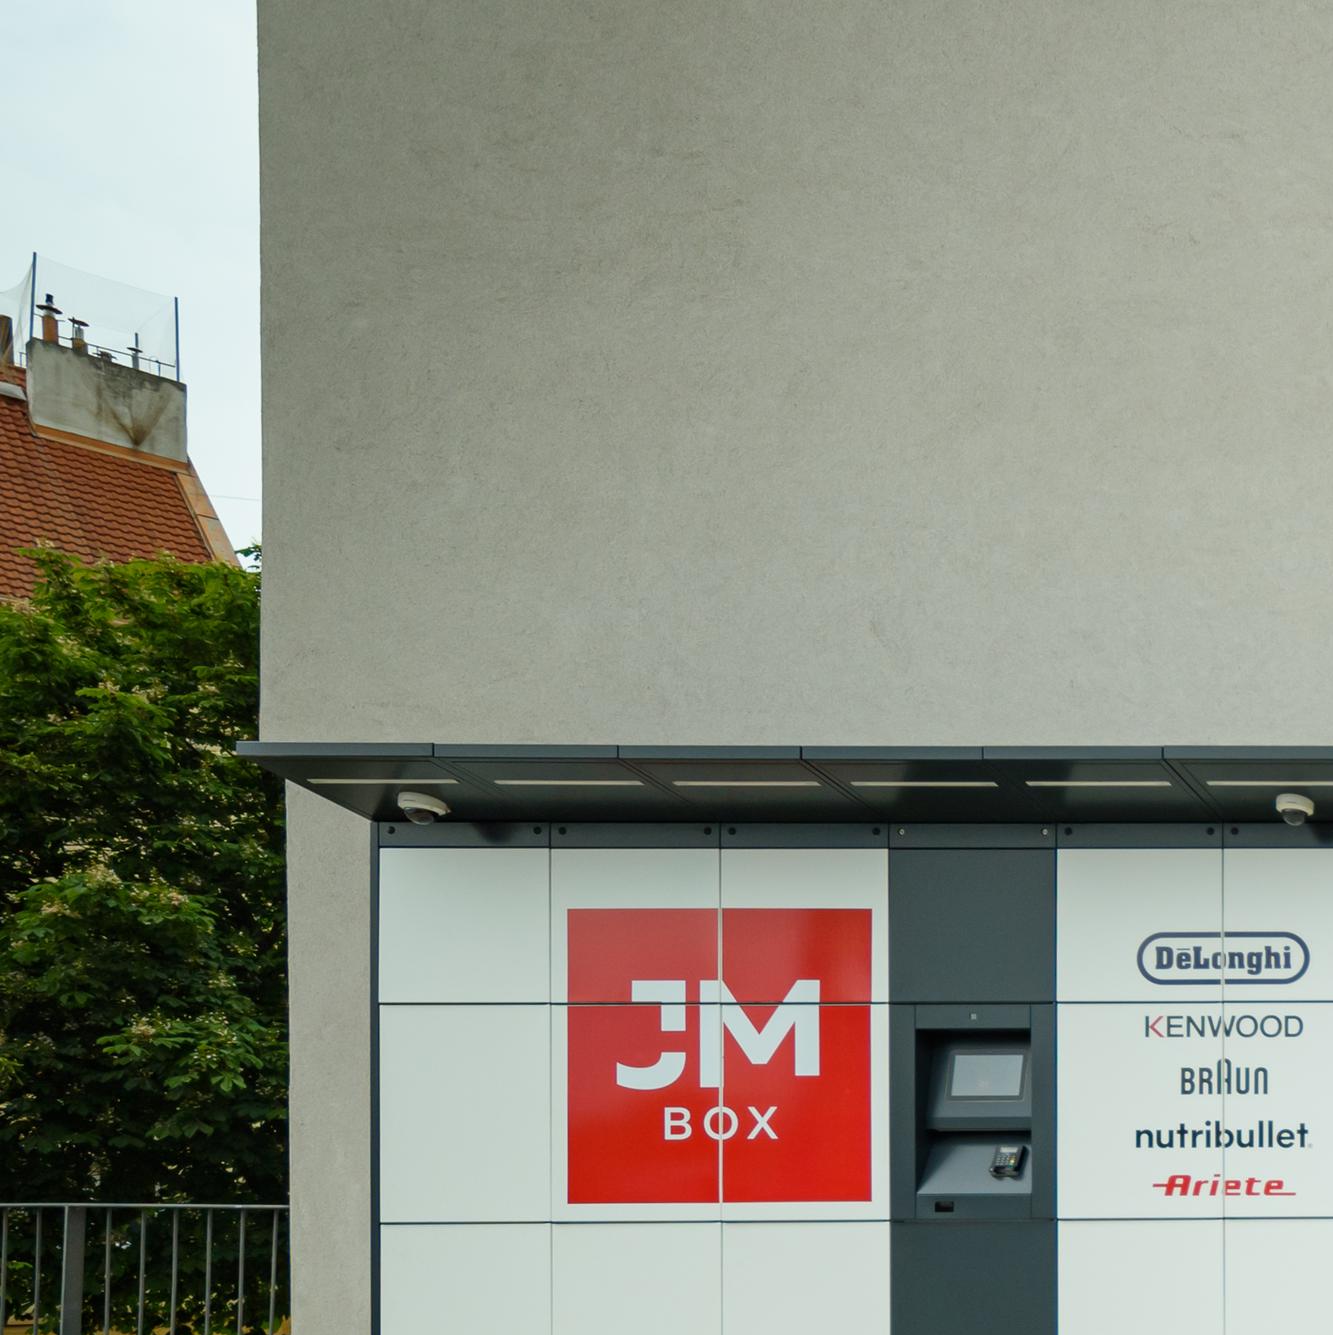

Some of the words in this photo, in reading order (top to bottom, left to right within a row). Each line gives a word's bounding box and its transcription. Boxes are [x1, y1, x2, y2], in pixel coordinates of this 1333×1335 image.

[617, 979, 821, 1090] JM
[1144, 1015, 1304, 1038] KENWOOD
[1180, 1059, 1269, 1095] BRAUN
[664, 1106, 779, 1141] BOX
[1135, 1121, 1309, 1149] nutribullet
[1153, 1174, 1297, 1196] Ariete
